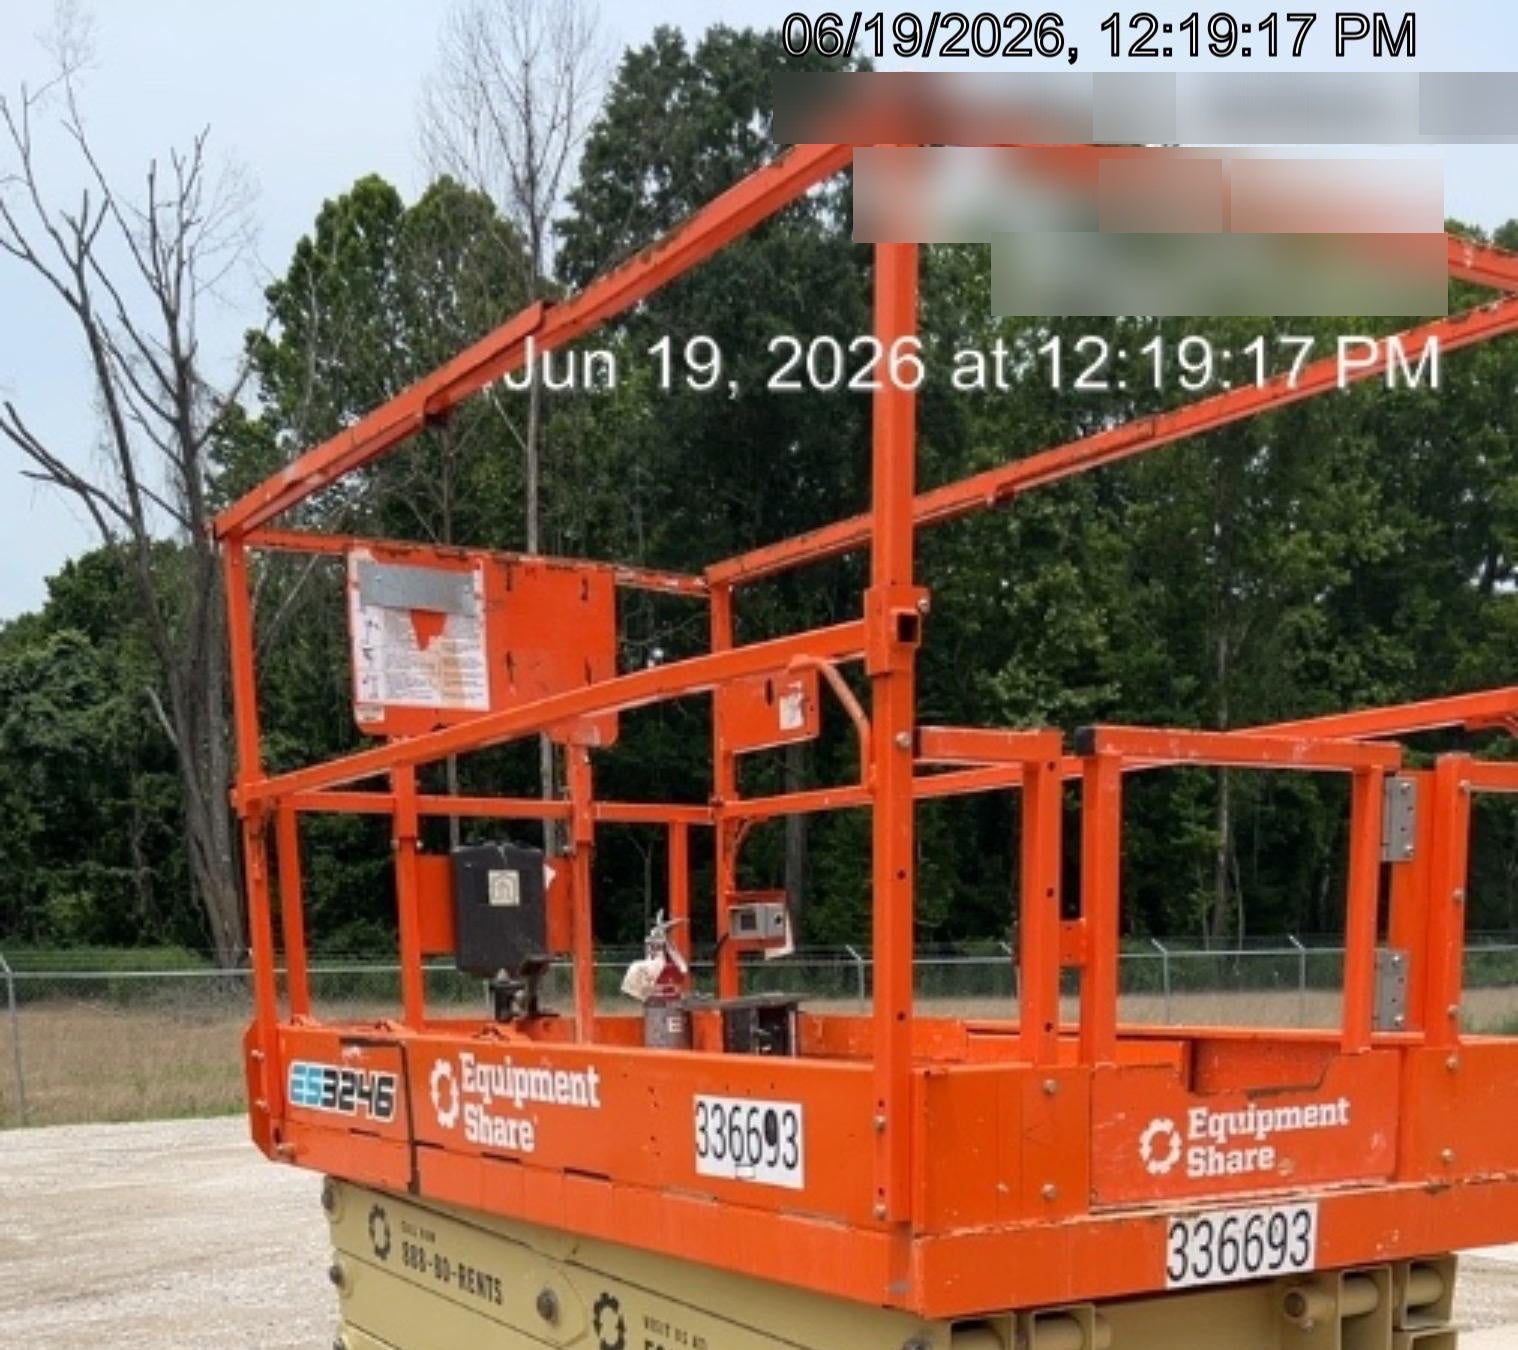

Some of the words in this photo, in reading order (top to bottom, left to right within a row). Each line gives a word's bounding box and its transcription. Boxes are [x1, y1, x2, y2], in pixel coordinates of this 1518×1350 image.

[289, 1061, 398, 1123] ES3246
[458, 1051, 601, 1108] Equipment
[464, 1102, 535, 1152] Share
[696, 1101, 798, 1170] 336693
[1187, 1097, 1350, 1143] Equipment
[1187, 1145, 1276, 1178] Share
[1167, 1208, 1312, 1282] 336693
